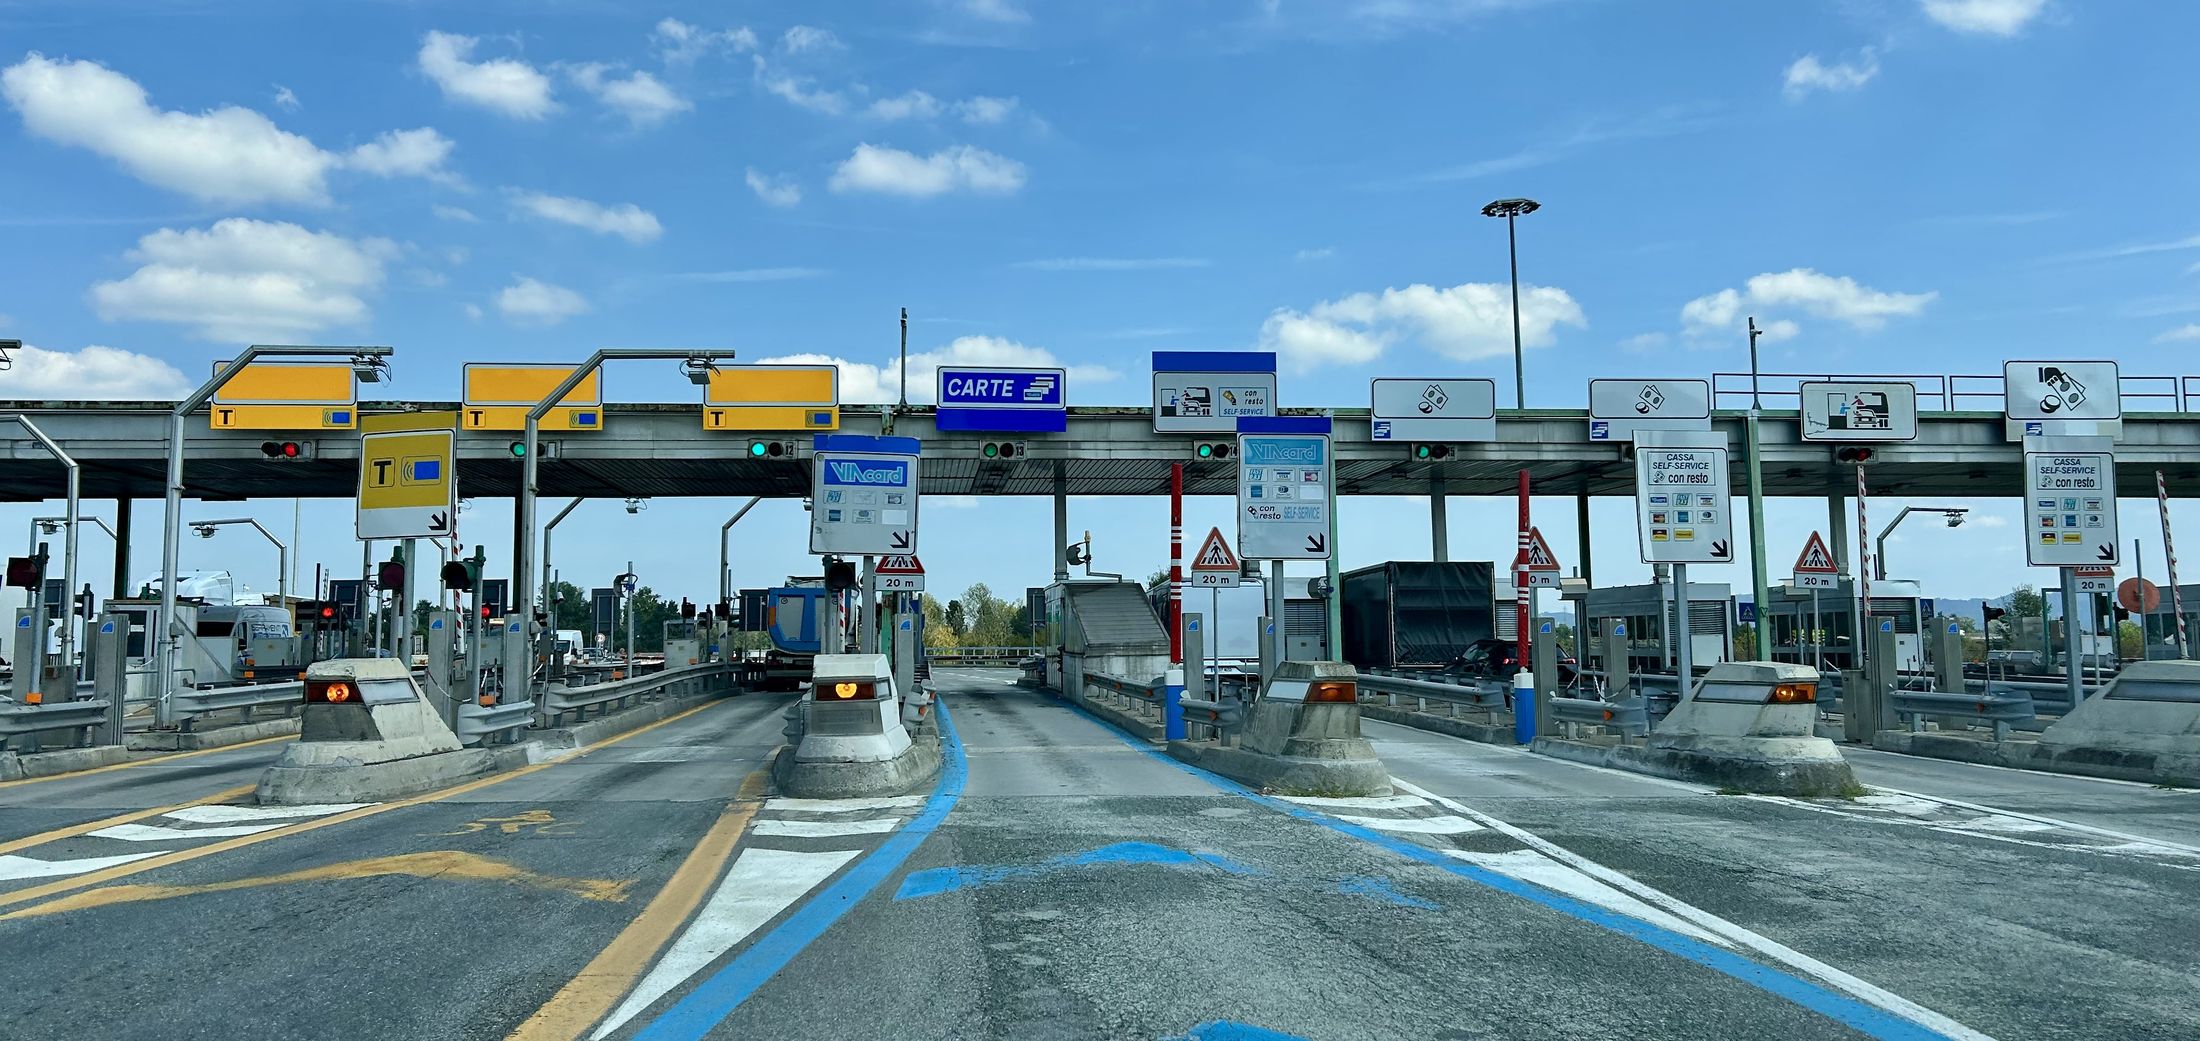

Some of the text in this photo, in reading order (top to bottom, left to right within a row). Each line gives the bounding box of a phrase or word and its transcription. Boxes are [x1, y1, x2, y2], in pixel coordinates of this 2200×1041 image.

[947, 378, 1015, 397] CARTE
[218, 409, 233, 424] T
[469, 411, 483, 425] T
[710, 411, 724, 425] T
[1666, 453, 1695, 461] CASSA
[2053, 458, 2081, 466] CASSA
[1652, 462, 1710, 470] SELF-SERVICE
[2040, 466, 2096, 475] SELF-SERVICE
[373, 460, 392, 485] T
[830, 462, 904, 484] VIAcard
[1668, 472, 1709, 484] con resto
[2055, 476, 2095, 488] con resto
[1259, 512, 1282, 520] resto
[886, 578, 914, 588] 20 m
[1202, 575, 1217, 584] 20
[1804, 577, 1818, 586] 20
[2081, 581, 2095, 590] 20
